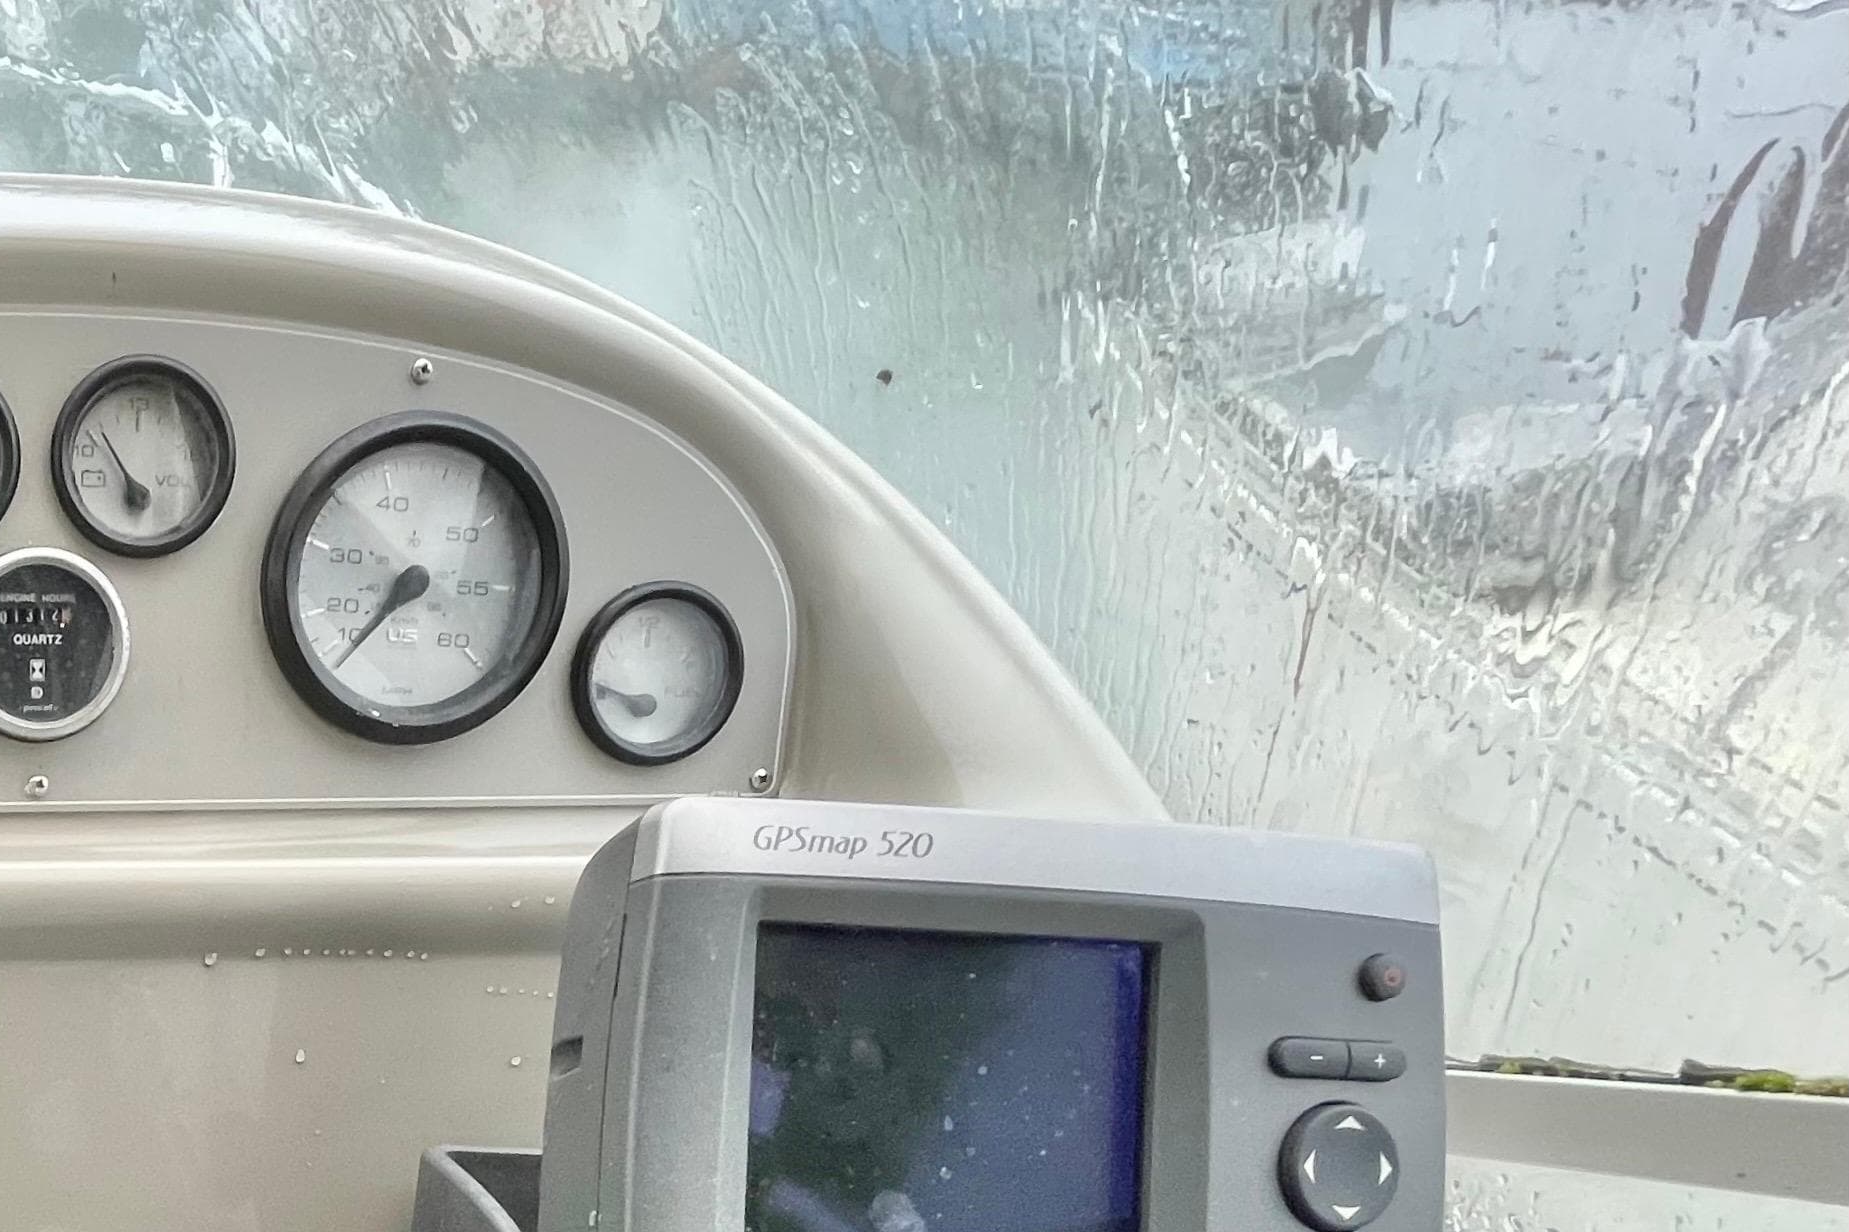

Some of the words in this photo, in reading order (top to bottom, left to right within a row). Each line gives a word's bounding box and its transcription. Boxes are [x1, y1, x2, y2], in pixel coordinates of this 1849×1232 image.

[376, 496, 410, 512] 40
[445, 526, 480, 543] 50
[329, 548, 363, 565] 30
[456, 580, 490, 597] 55
[326, 597, 359, 614] 20
[13, 633, 64, 646] QUARTZ
[437, 632, 471, 649] 60
[752, 824, 868, 860] GPSmap
[877, 831, 935, 858] 520
